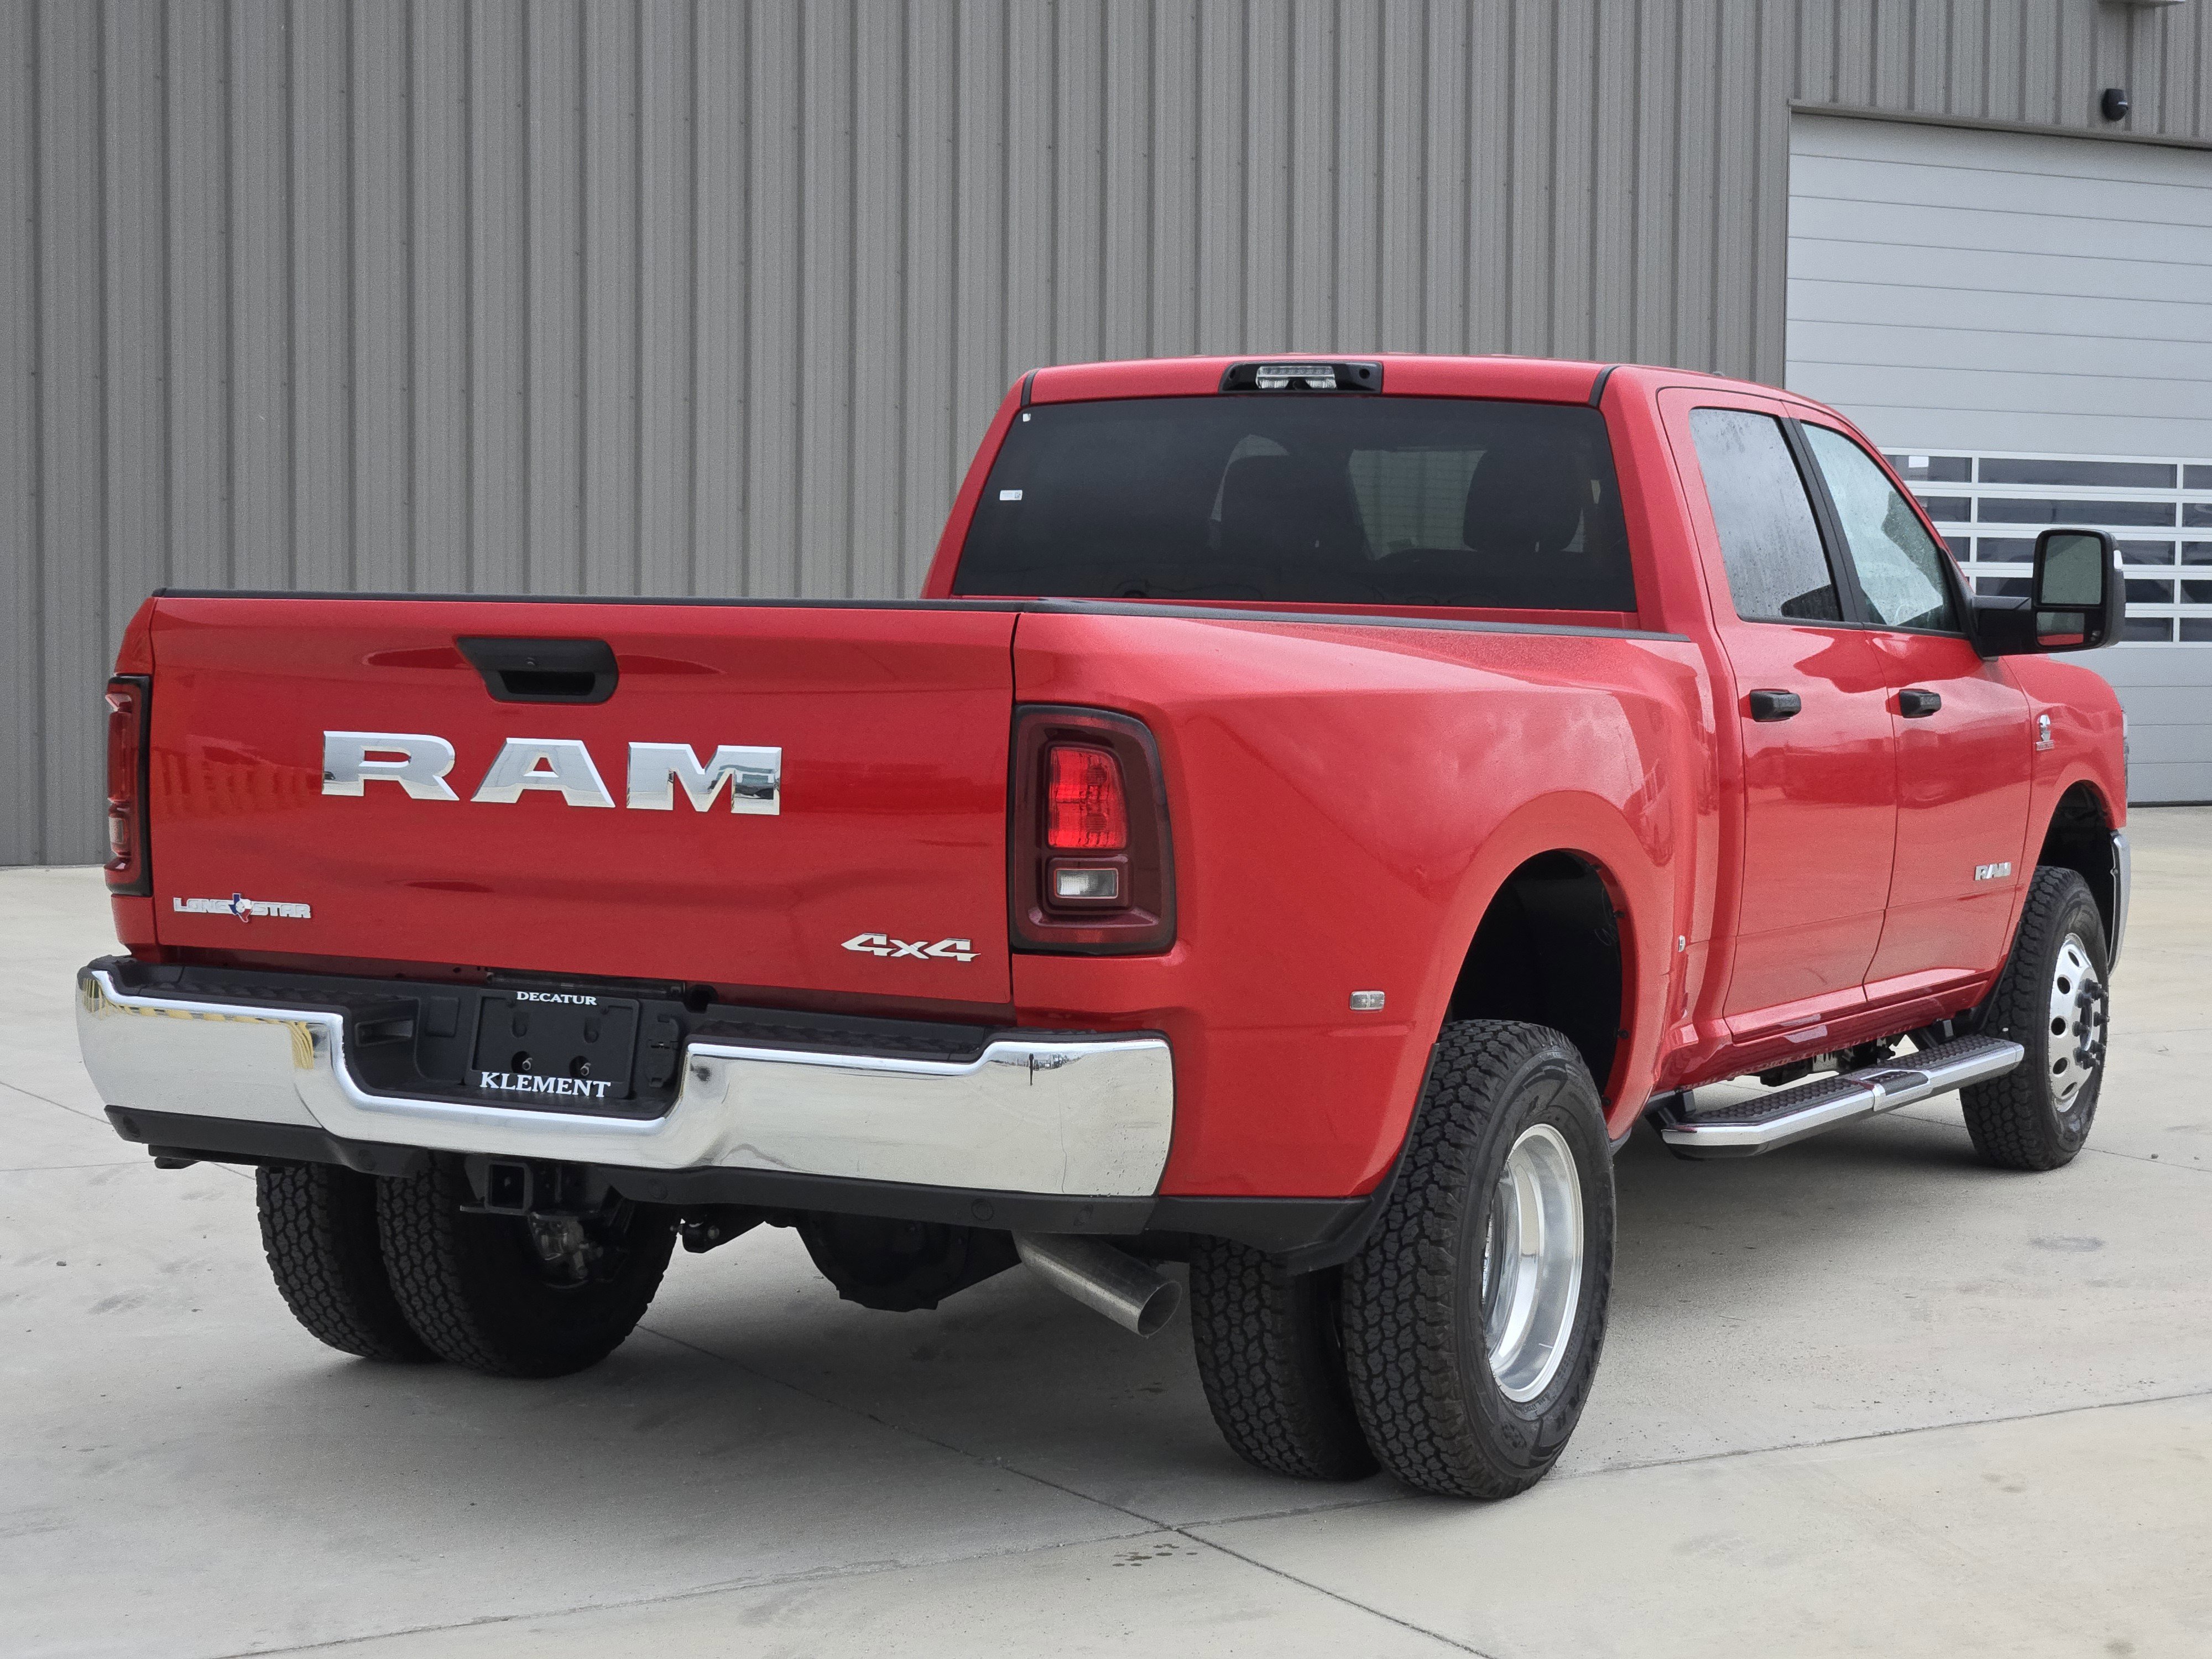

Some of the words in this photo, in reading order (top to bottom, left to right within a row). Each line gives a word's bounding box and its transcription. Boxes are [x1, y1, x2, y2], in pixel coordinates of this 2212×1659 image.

[322, 731, 781, 815] RAM
[1975, 862, 2011, 881] RAM
[173, 898, 231, 915] LONE
[251, 901, 311, 919] STAR
[517, 991, 597, 1005] DECATUR
[479, 1072, 611, 1098] KLEMENT
